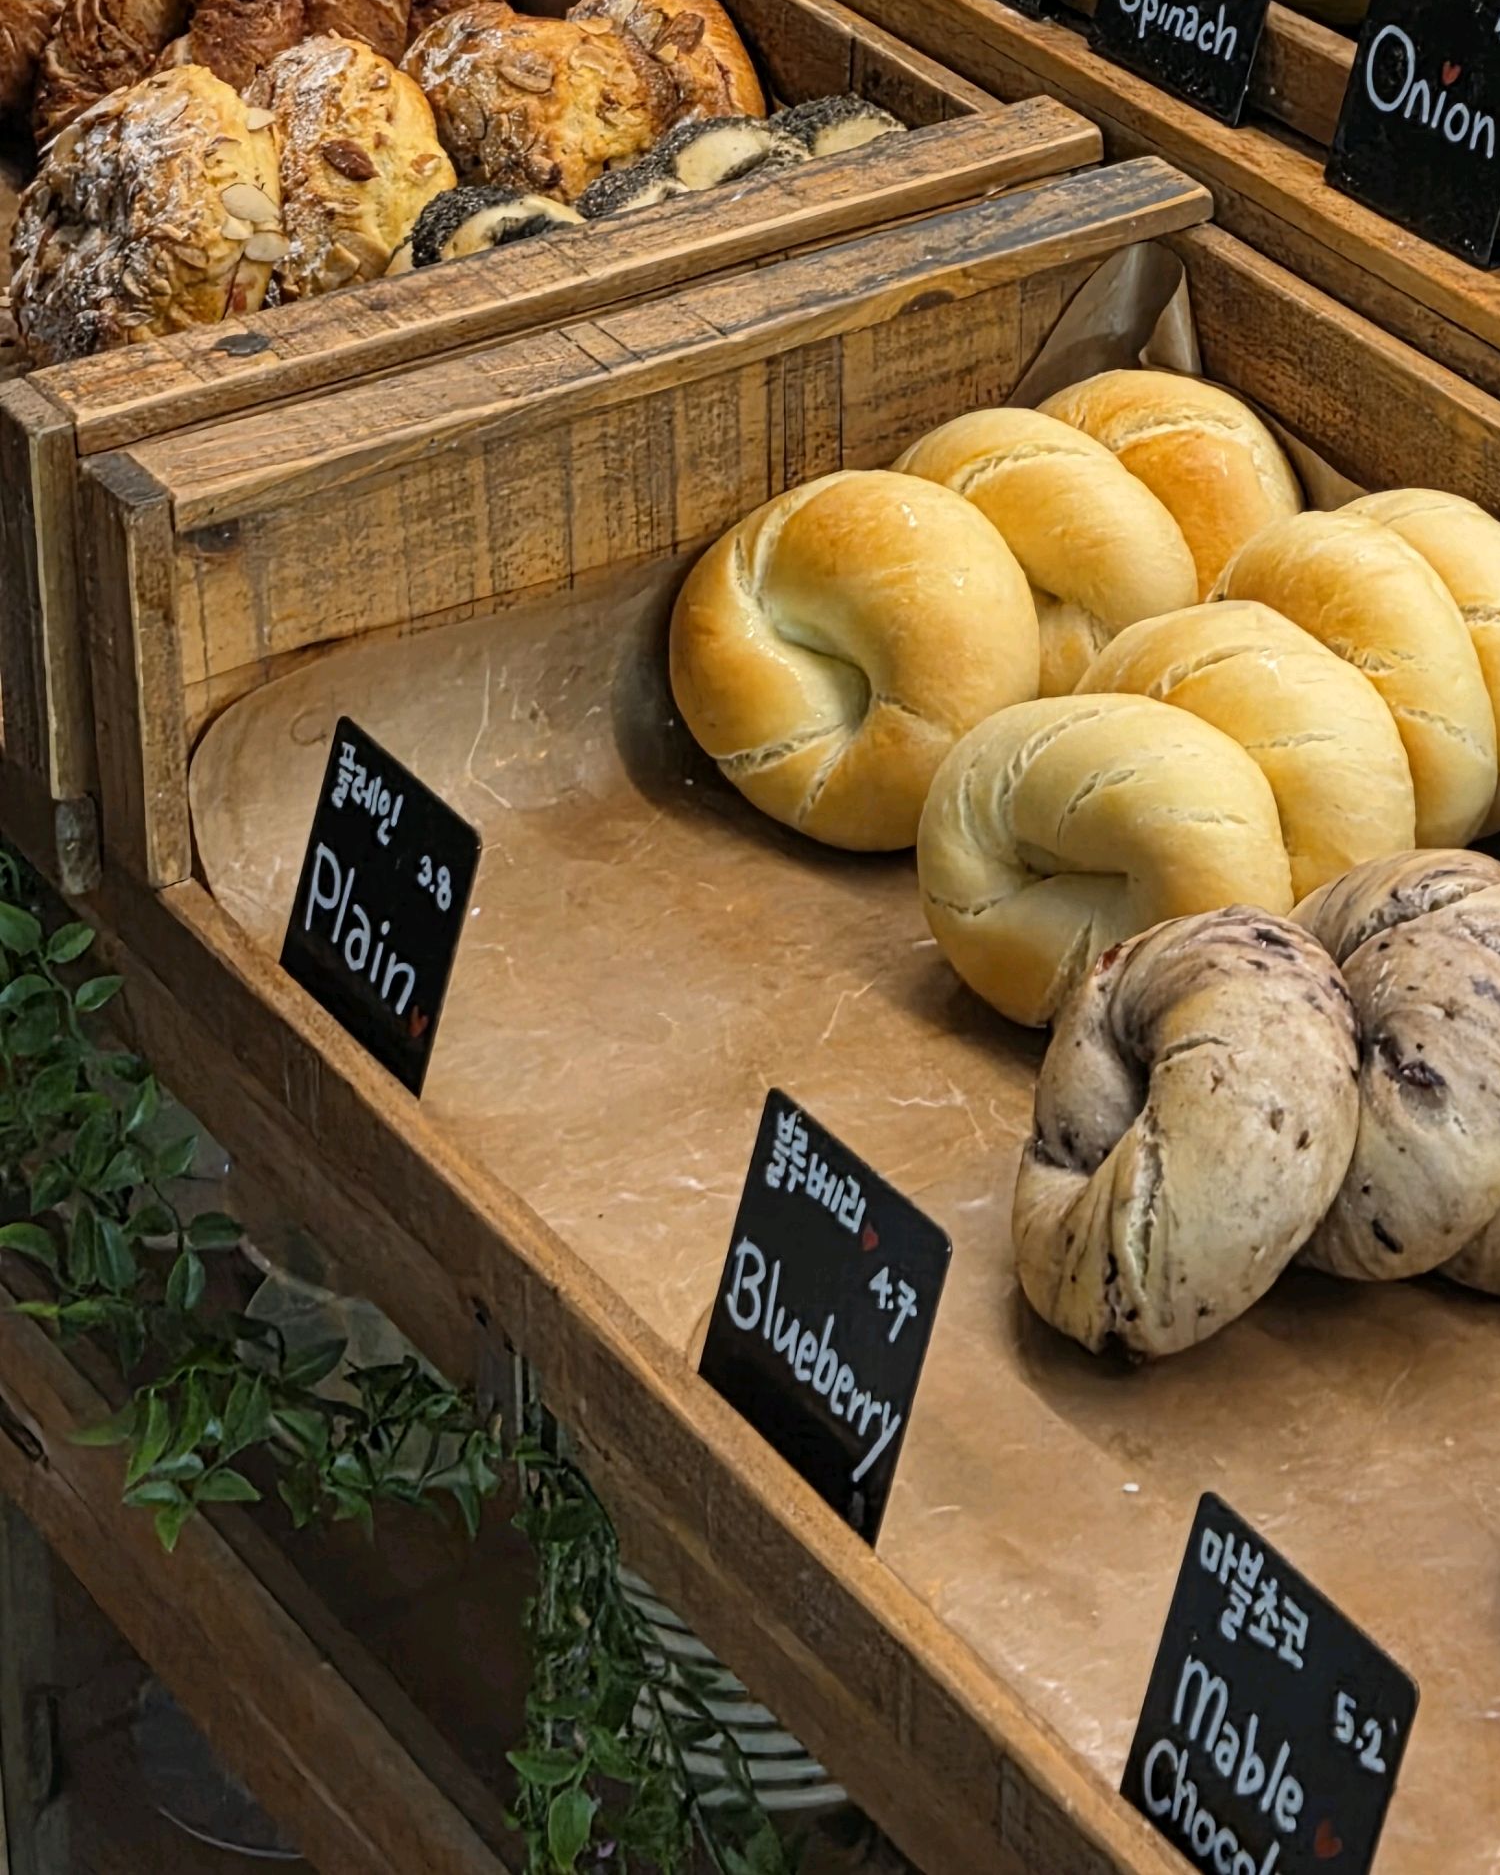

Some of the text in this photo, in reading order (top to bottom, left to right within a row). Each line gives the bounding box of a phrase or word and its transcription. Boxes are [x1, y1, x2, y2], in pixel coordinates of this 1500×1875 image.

[1366, 24, 1496, 159] Onion
[331, 741, 403, 846] 플레인
[304, 841, 417, 1016] Plain
[416, 854, 454, 913] 3.8
[765, 1110, 868, 1234] 블루베리
[726, 1235, 903, 1483] Blueberry
[867, 1265, 919, 1344] 4.7
[1199, 1527, 1310, 1670] 마블초코
[1333, 1689, 1387, 1774] 5.2
